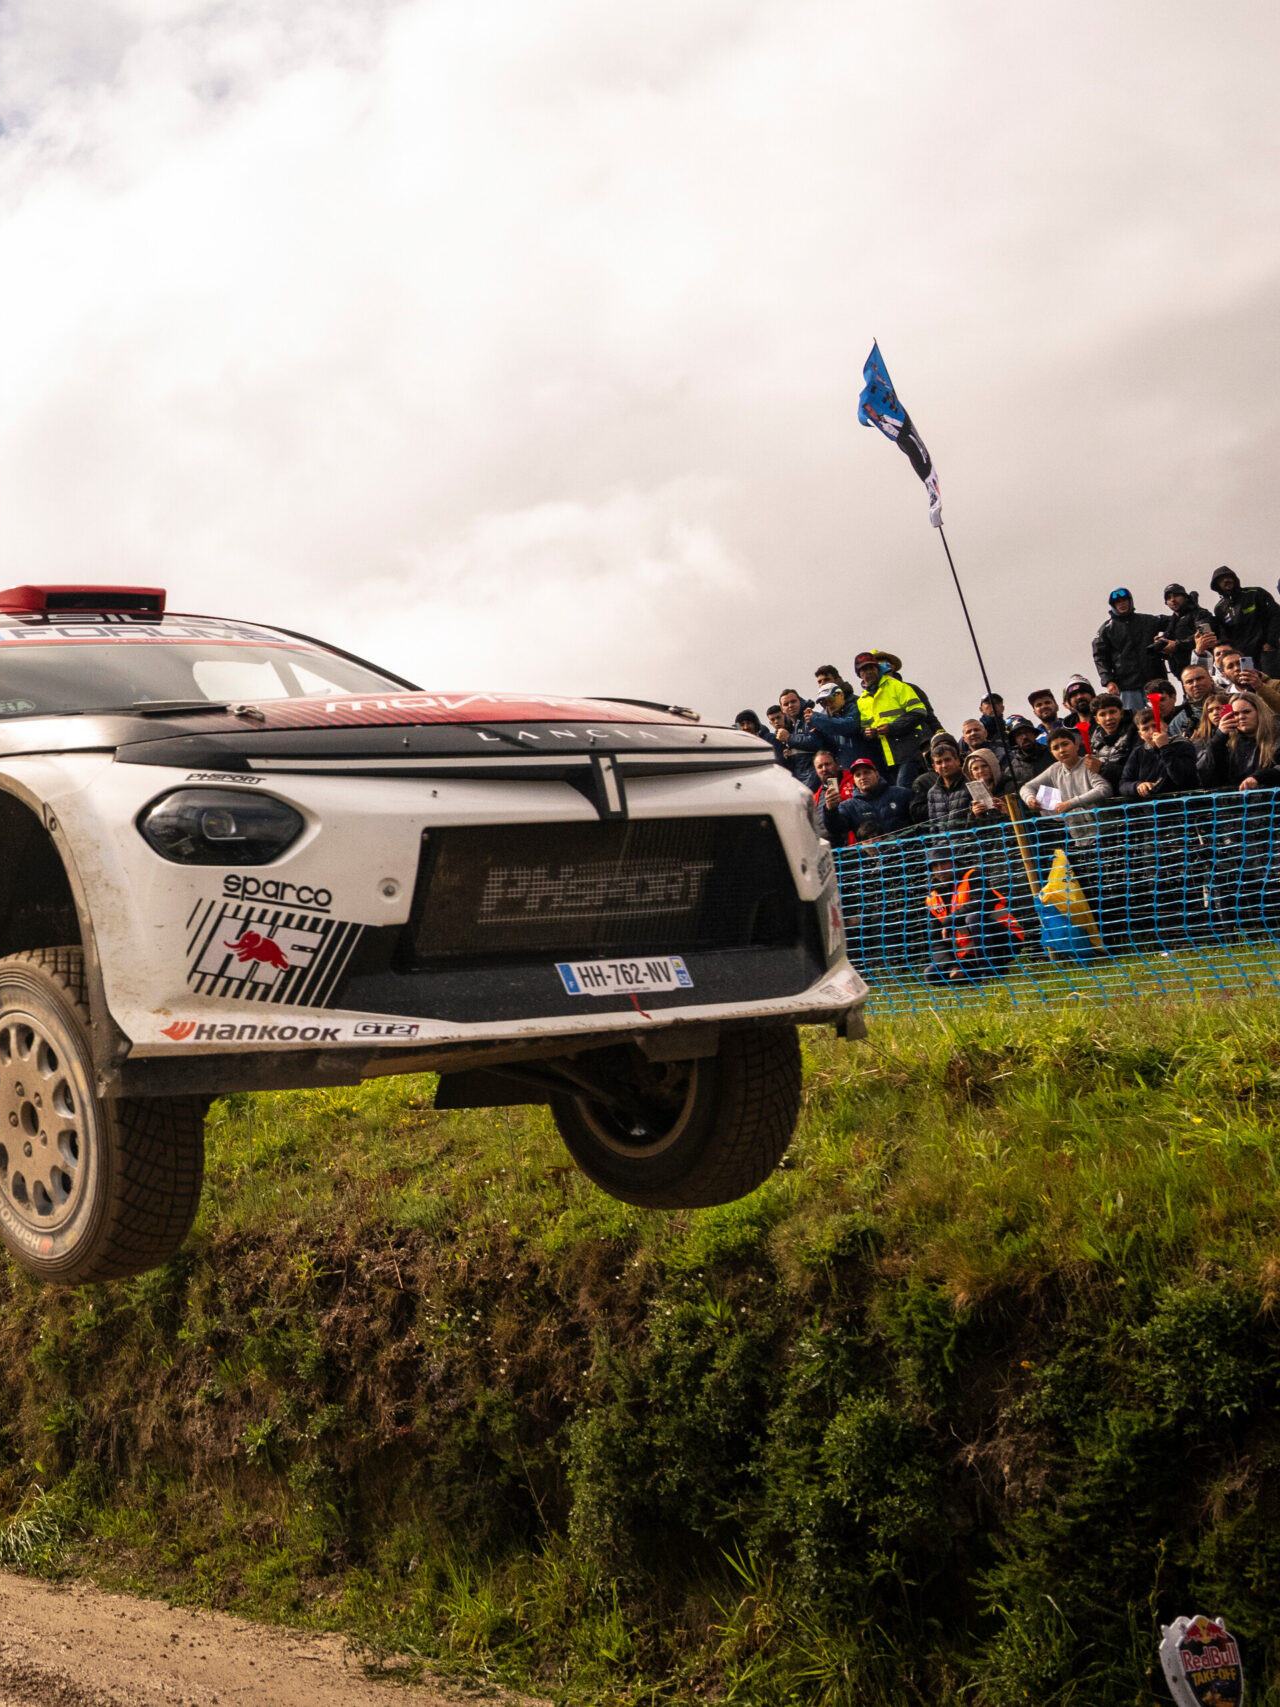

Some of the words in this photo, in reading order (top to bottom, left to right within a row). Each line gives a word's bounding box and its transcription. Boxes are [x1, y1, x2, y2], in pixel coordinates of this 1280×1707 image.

[477, 729, 659, 742] LANCIA
[223, 874, 332, 907] sparco
[576, 960, 673, 988] HH-762-NV
[1181, 1646, 1208, 1671] Red
[1210, 1642, 1238, 1667] Bull
[1191, 1668, 1237, 1686] TAKE-OFF
